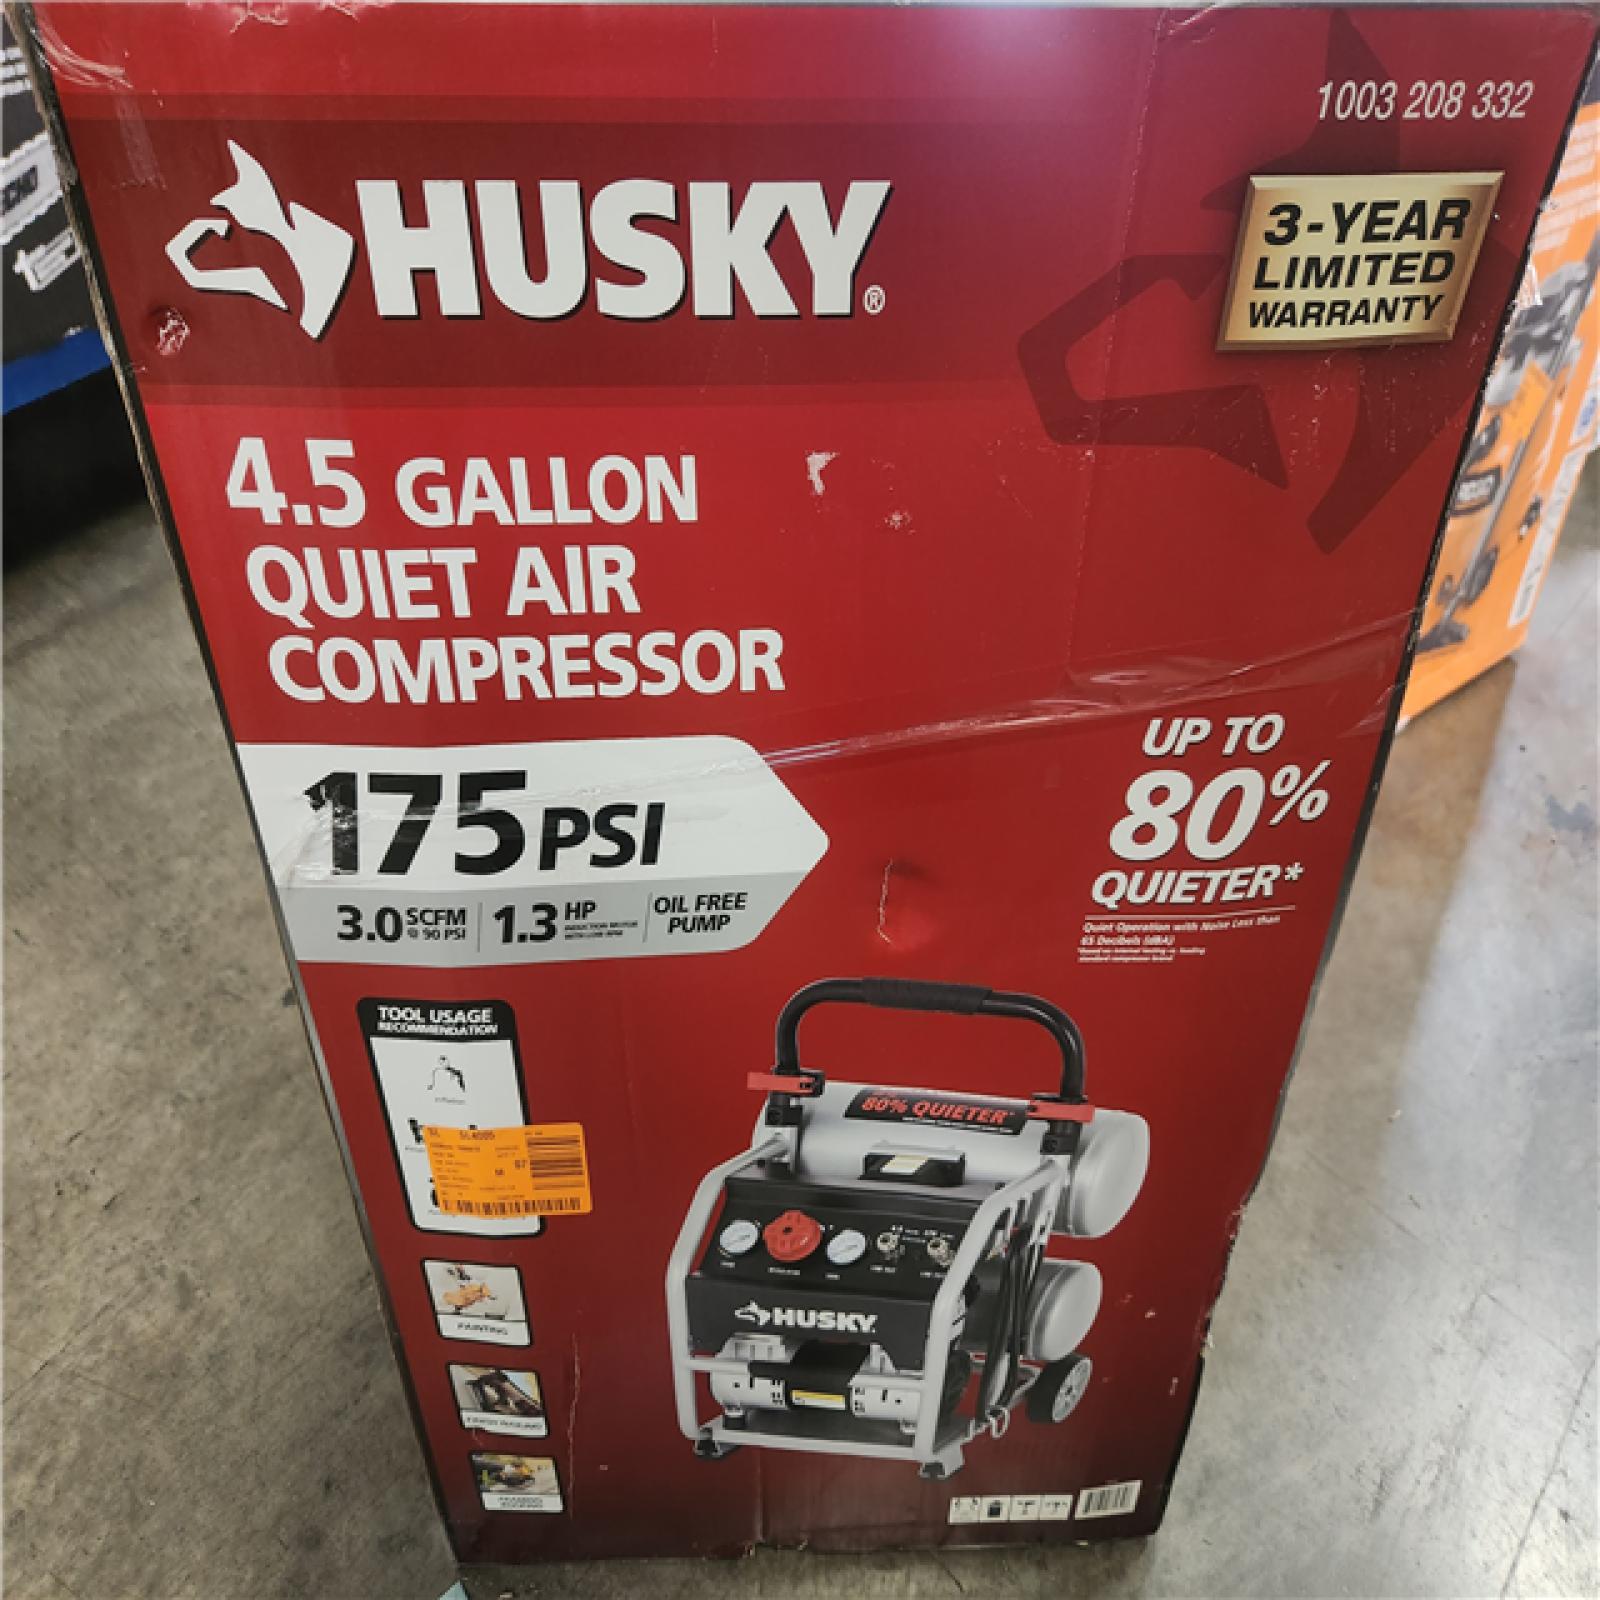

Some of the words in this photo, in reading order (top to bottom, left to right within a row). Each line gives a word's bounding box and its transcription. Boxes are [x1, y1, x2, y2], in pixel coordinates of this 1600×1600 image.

[1317, 80, 1398, 120] 1003
[1403, 80, 1466, 120] 208
[1471, 80, 1534, 119] 332
[1263, 199, 1471, 246] 3-YEAR
[355, 178, 894, 320] HUSKY
[1253, 251, 1456, 289] LIMITED
[1249, 294, 1443, 328] WARRANTY
[225, 437, 367, 527] 4.5
[395, 455, 698, 526] GALLON
[246, 545, 477, 628] QUIET
[506, 546, 641, 616] AIR
[269, 629, 785, 704] COMPRESSOR
[1142, 717, 1212, 756] UP
[1221, 714, 1285, 755] TO
[304, 769, 527, 876] 175
[538, 801, 666, 872] PSI
[1109, 759, 1332, 861] 80%
[336, 904, 402, 942] 3.0
[405, 907, 467, 926] SCFM
[493, 901, 558, 944] 1.3
[564, 899, 597, 920] HP
[654, 895, 689, 915] OIL
[695, 891, 748, 911] FREE
[667, 914, 731, 935] PUMP
[377, 1005, 426, 1023] TOOL
[429, 1008, 493, 1023] USAGE
[861, 1096, 909, 1113] 80%
[911, 1100, 1009, 1126] QUIETER
[771, 1305, 878, 1334] HUSKY
